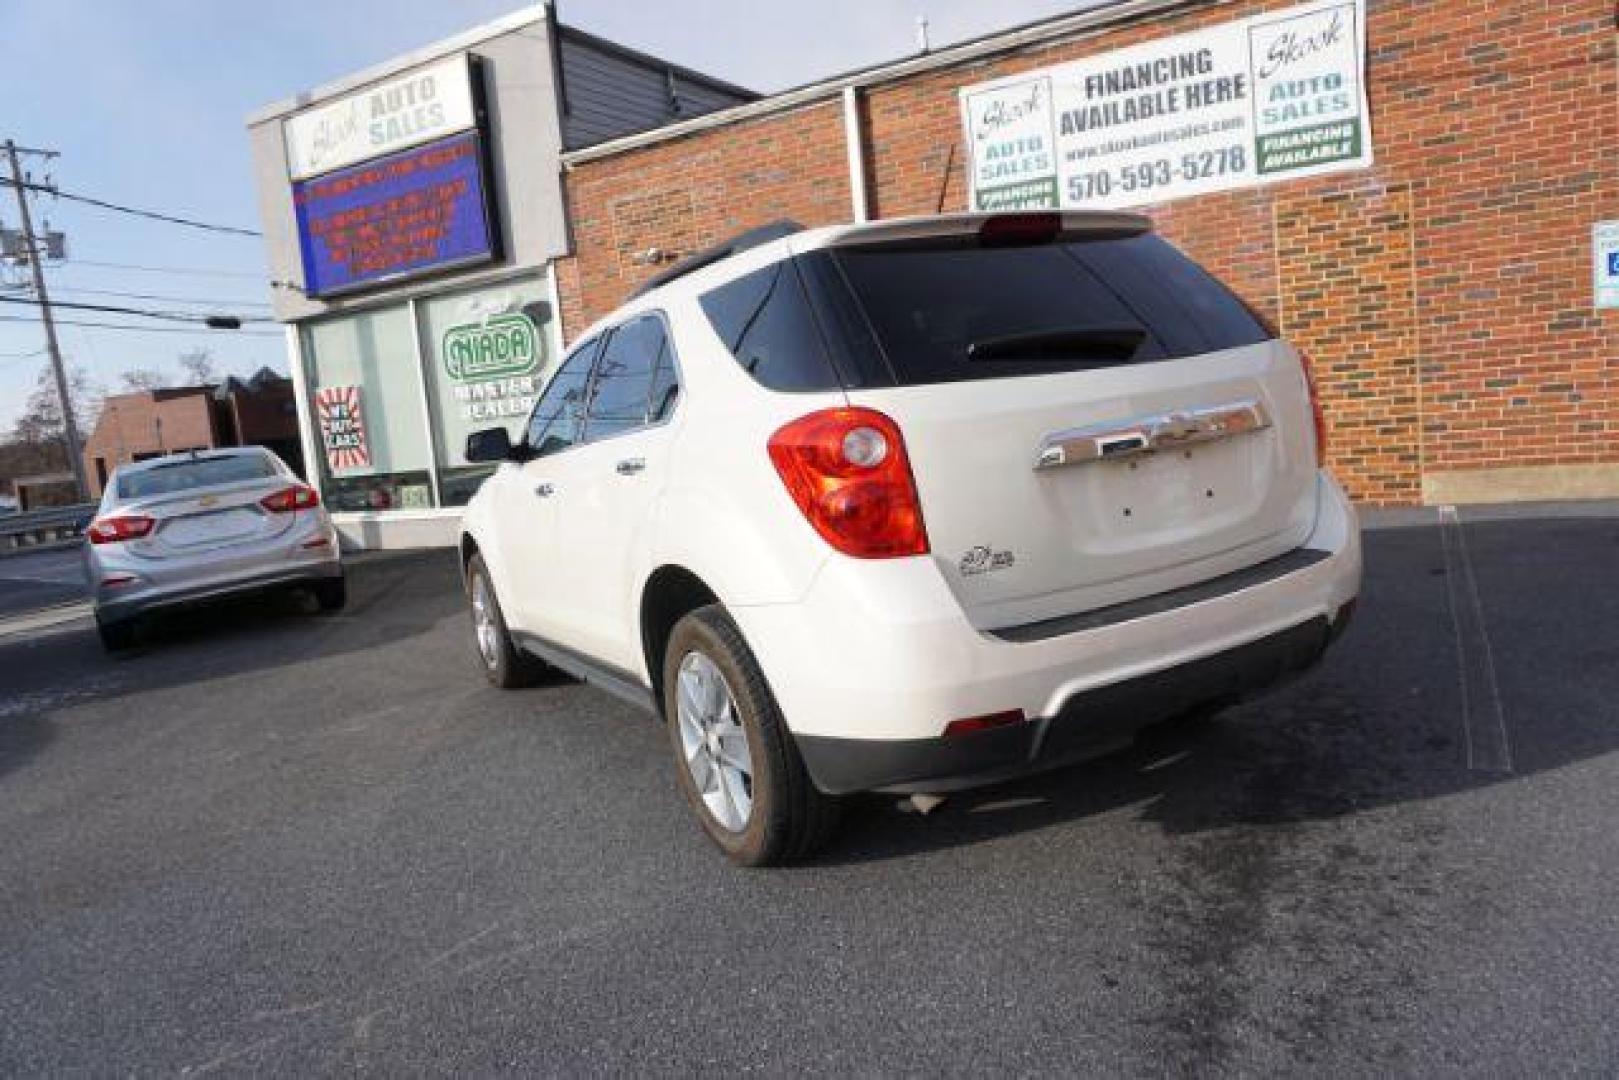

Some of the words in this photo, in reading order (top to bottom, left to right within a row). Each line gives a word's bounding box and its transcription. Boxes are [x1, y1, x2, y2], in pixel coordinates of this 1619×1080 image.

[1084, 48, 1212, 99] FINANCING
[1269, 72, 1342, 102] AUTO
[370, 75, 436, 119] AUTO
[1060, 87, 1180, 136] AVAILABLE
[1185, 73, 1247, 109] HERE
[1261, 94, 1350, 125] SALES
[368, 103, 446, 145] SALES
[979, 153, 1049, 181] SALES
[985, 136, 1043, 160] AUTO
[1067, 144, 1246, 202] 570-593-5278
